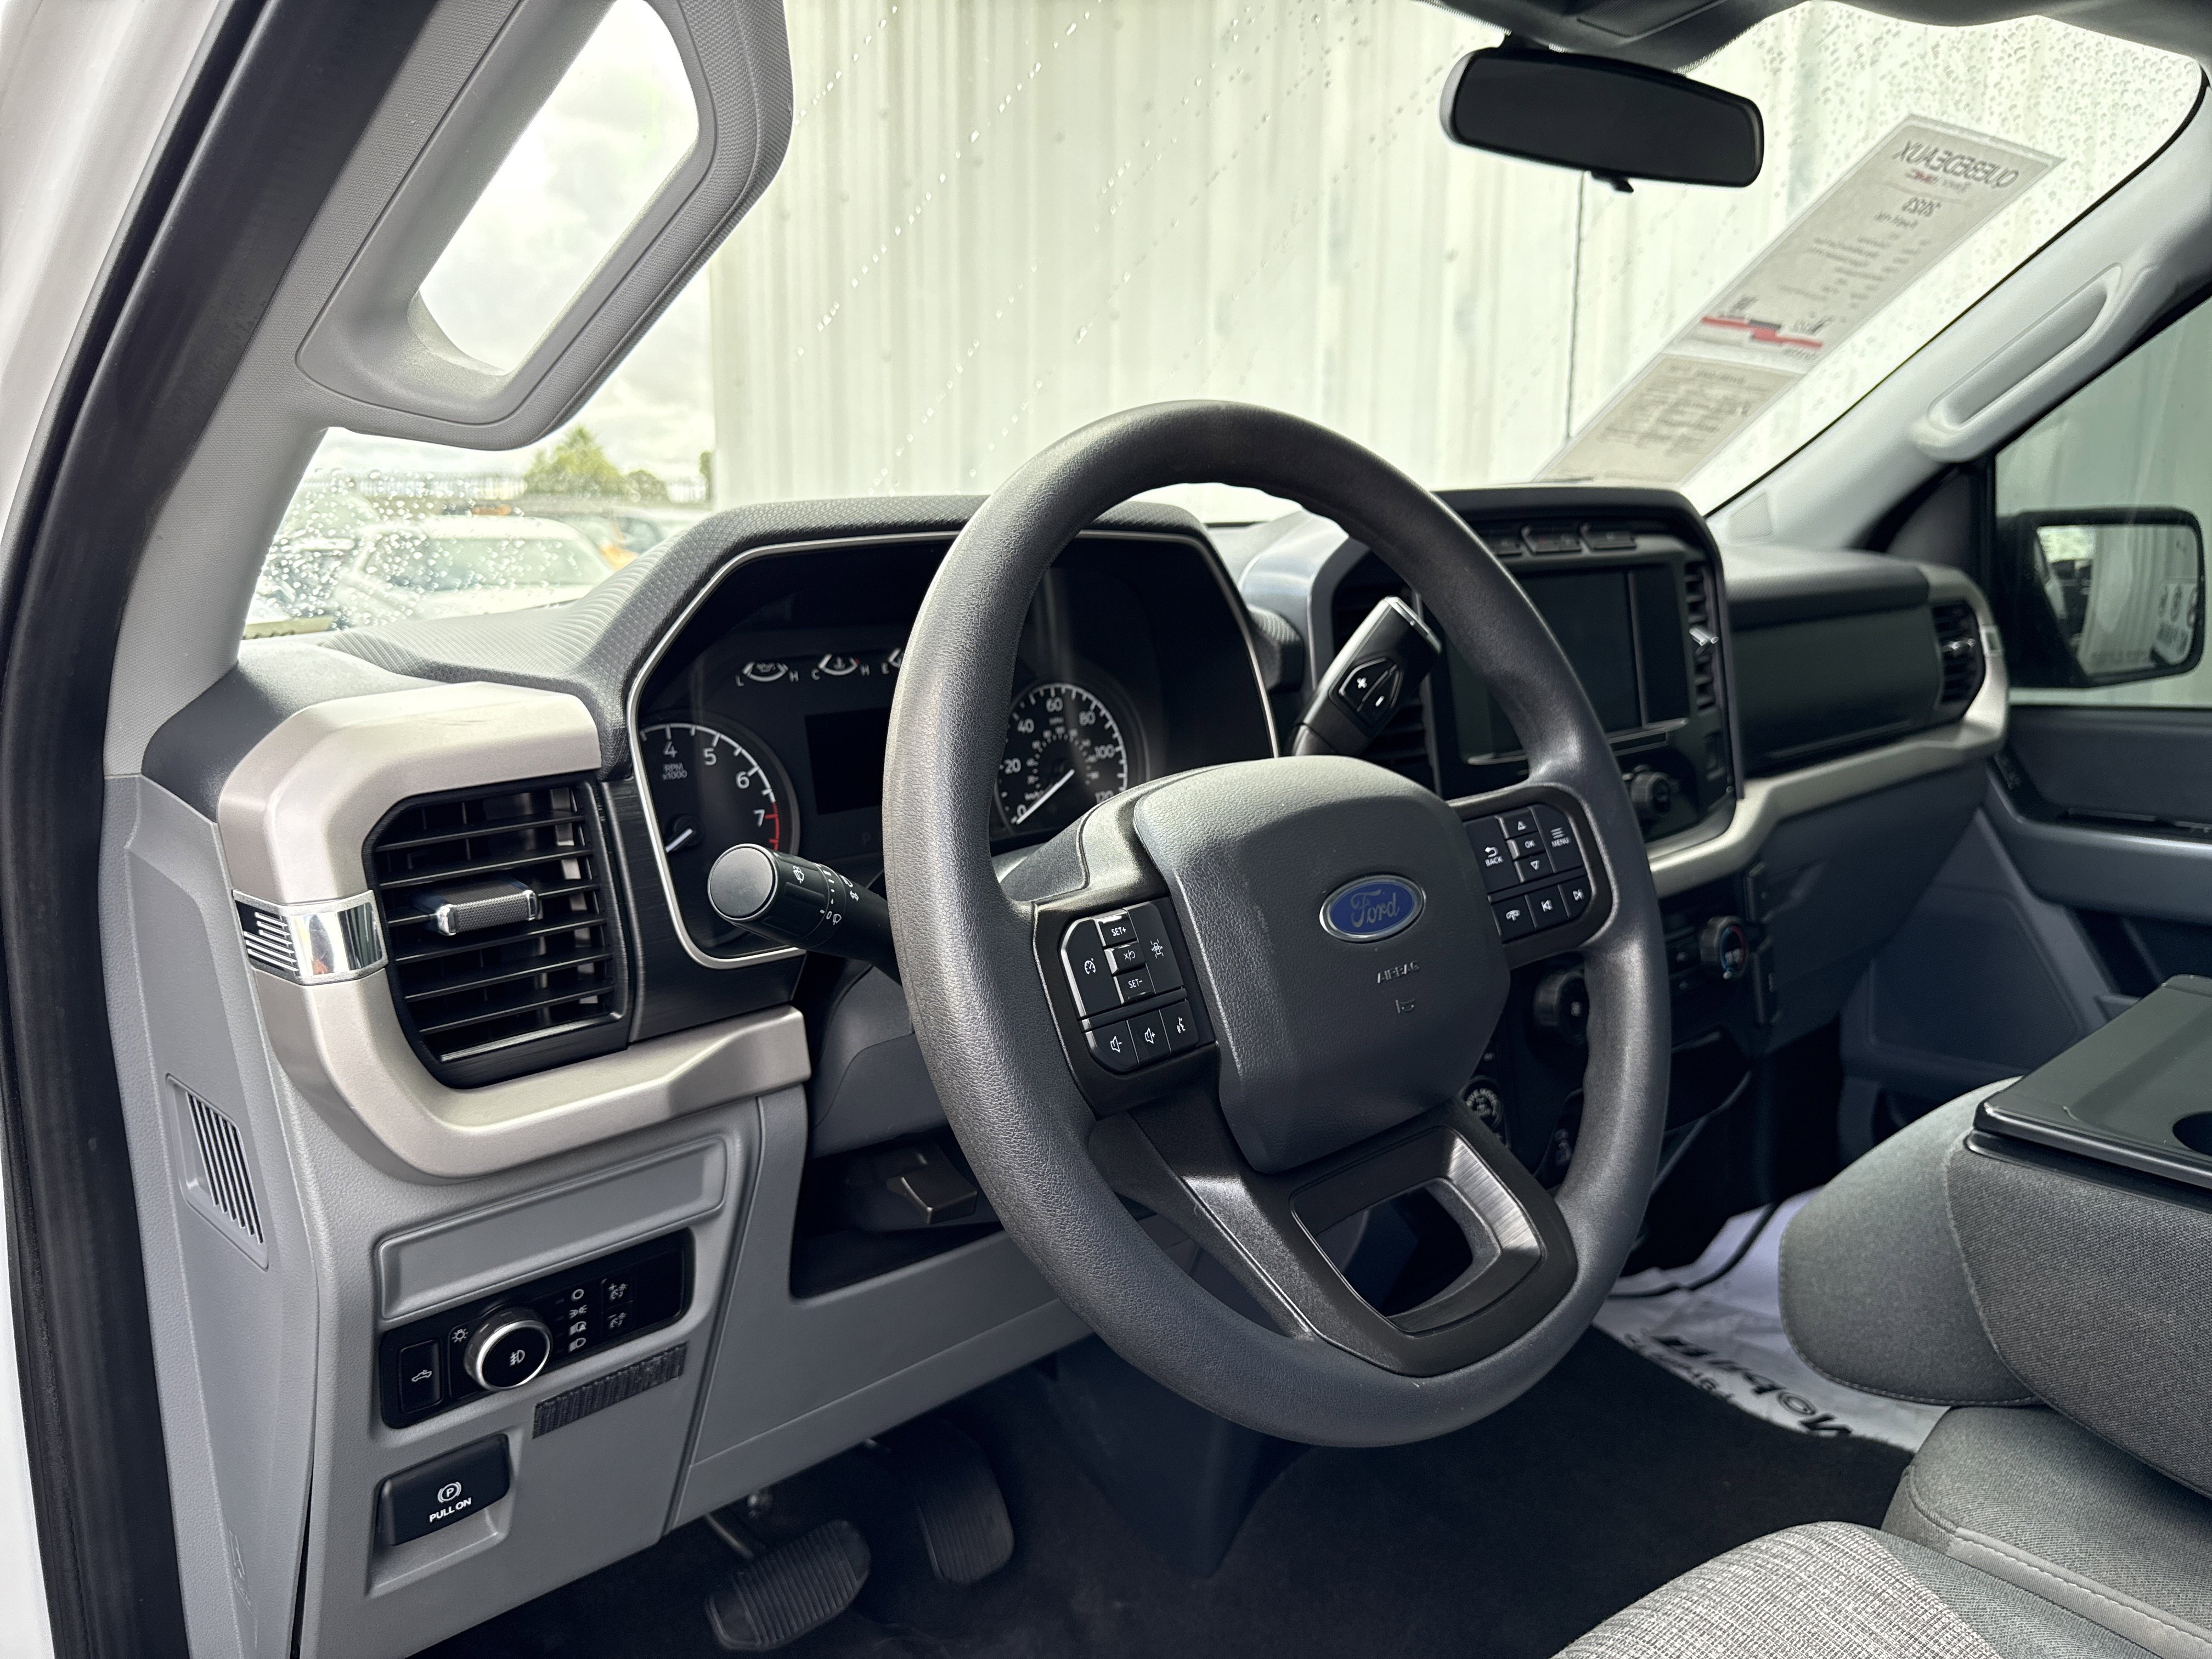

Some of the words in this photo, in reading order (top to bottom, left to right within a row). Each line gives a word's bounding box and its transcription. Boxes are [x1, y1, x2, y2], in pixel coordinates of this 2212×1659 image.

[735, 675, 744, 686] L
[788, 670, 799, 682] H
[811, 668, 820, 680] C
[1045, 696, 1063, 713] 60
[1017, 718, 1035, 734] 40
[1079, 710, 1096, 726] 80
[663, 742, 678, 759] 4
[703, 748, 718, 766] 5
[1094, 743, 1116, 760] 100
[664, 763, 685, 772] RPM
[1004, 757, 1022, 775] 20
[735, 771, 750, 789] 6
[753, 809, 766, 827] 7
[1525, 839, 1536, 849] OK
[1551, 837, 1571, 848] MENU
[1485, 855, 1504, 867] BACK
[1350, 888, 1400, 928] Ford
[1377, 961, 1420, 984] AIRBAG
[429, 1506, 455, 1523] PULL
[455, 1497, 472, 1510] ON
